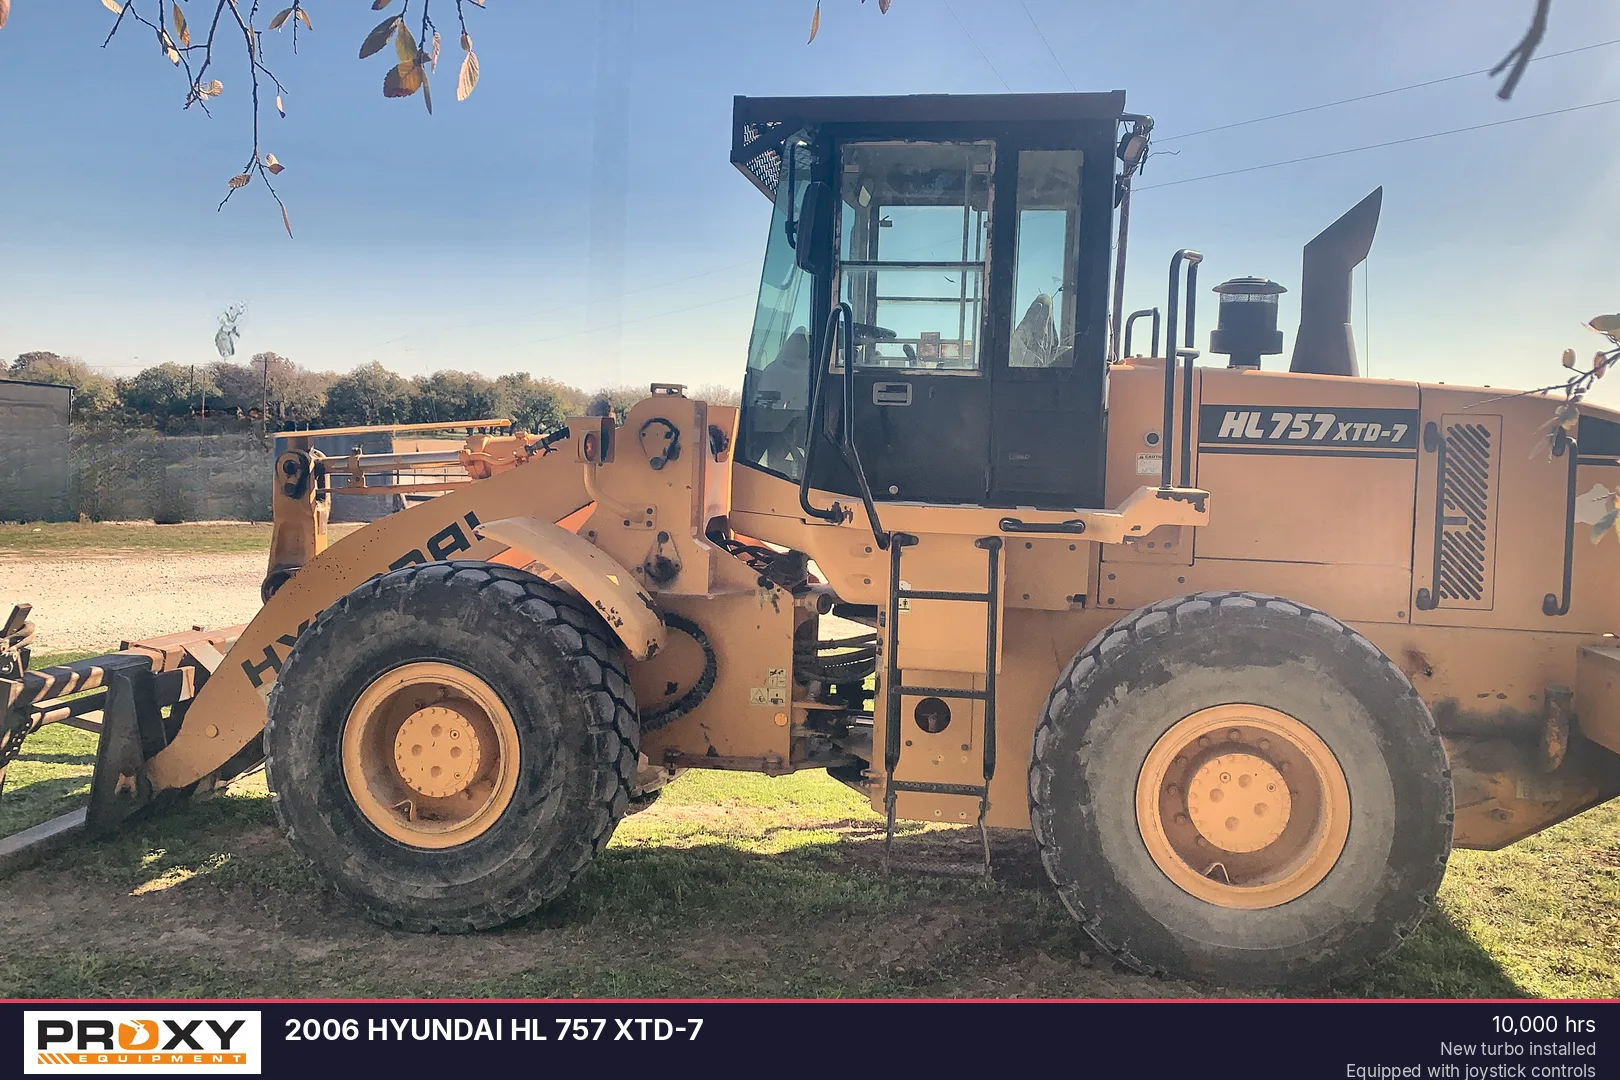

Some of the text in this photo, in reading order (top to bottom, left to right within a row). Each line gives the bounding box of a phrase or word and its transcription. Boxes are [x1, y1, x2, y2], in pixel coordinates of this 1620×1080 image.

[1218, 411, 1408, 443] HL 757 XTD-7
